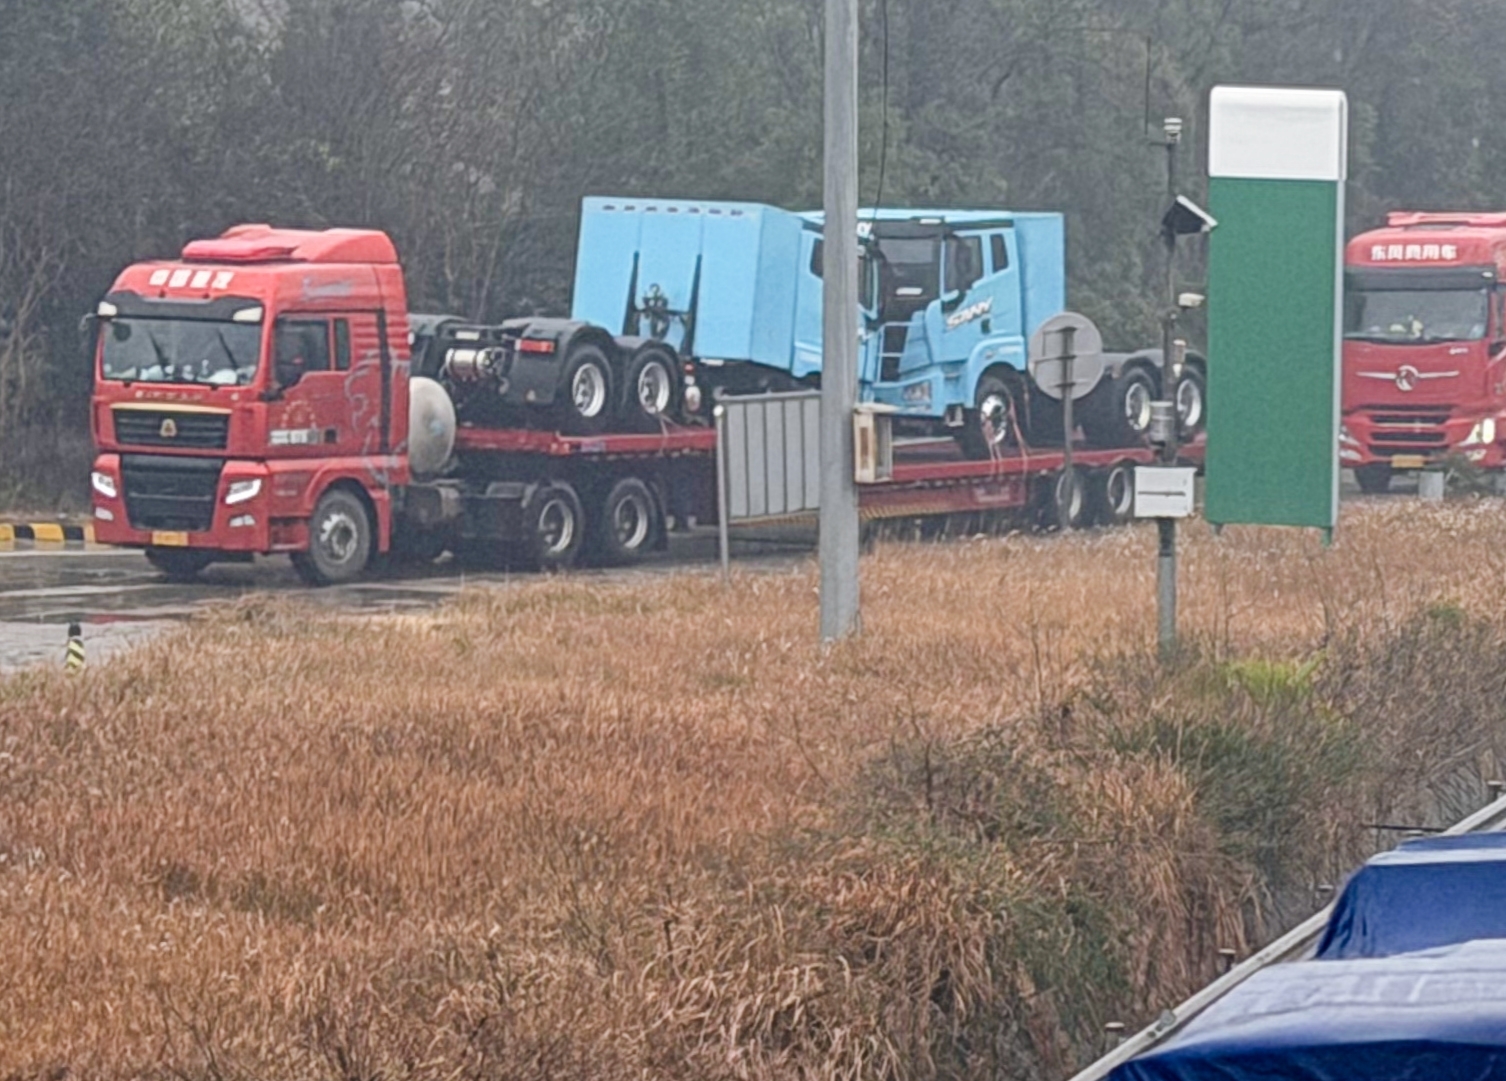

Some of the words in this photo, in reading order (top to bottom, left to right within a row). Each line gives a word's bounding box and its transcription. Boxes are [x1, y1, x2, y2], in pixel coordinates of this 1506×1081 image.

[1371, 244, 1457, 261] 东风商用车
